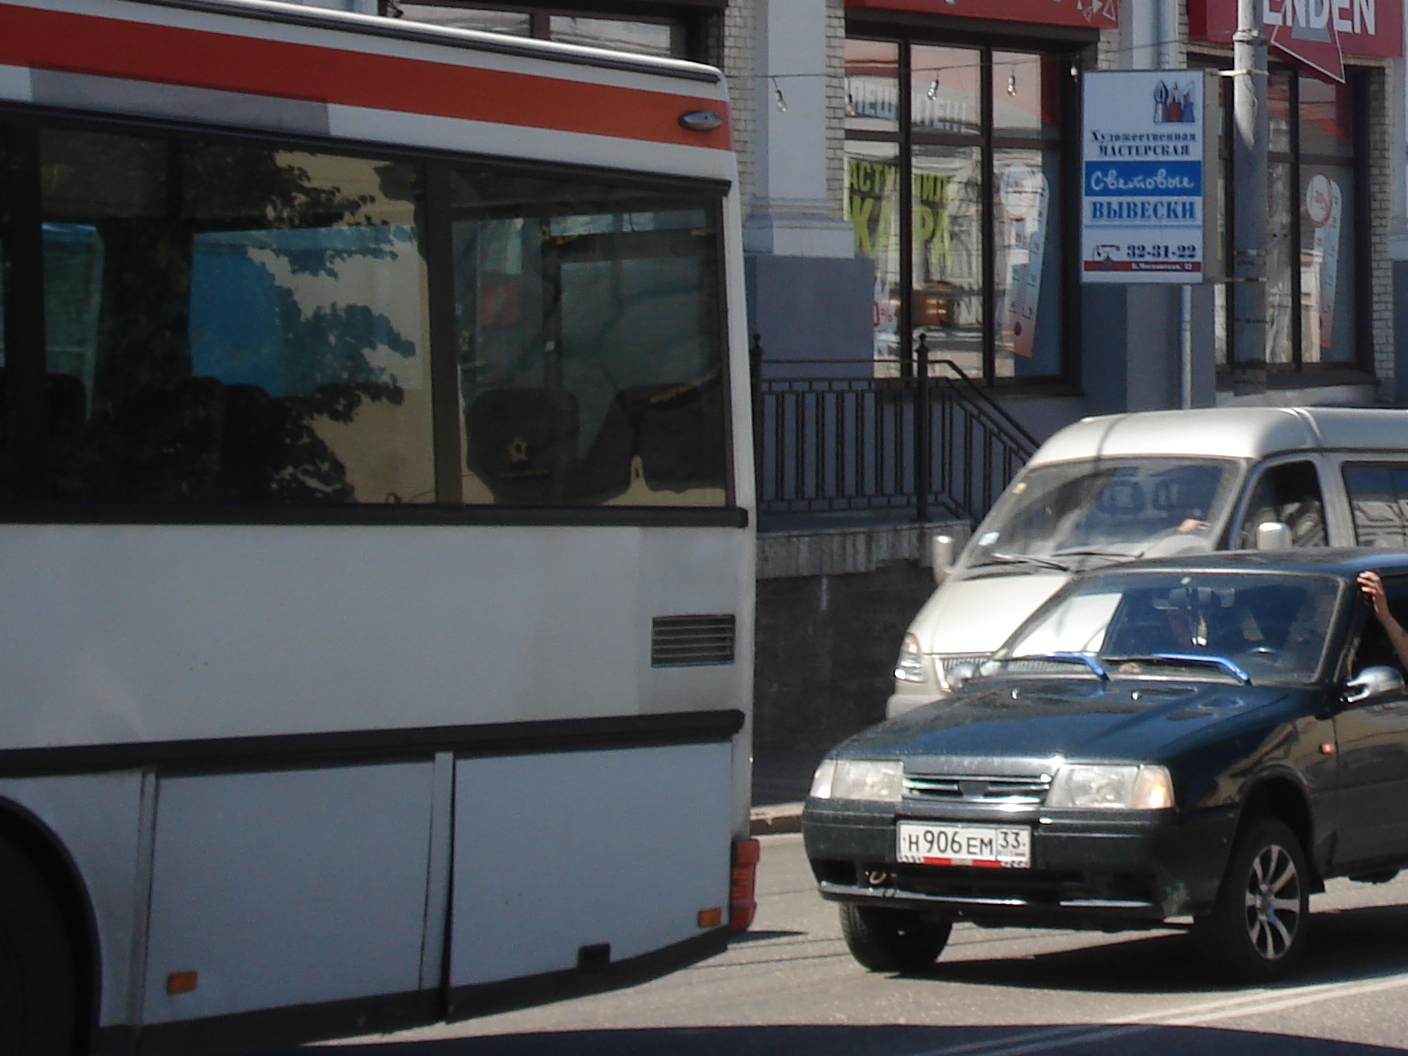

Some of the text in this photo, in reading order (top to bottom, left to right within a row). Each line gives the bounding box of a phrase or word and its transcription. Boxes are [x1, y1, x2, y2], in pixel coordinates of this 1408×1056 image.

[1090, 130, 1196, 144] Художественная
[1098, 144, 1190, 157] МАСТЕРСКАЯ
[1090, 167, 1196, 191] Световые
[1091, 200, 1195, 220] ВЫВЕСКИ
[1126, 244, 1197, 259] 32-31-22
[999, 831, 1021, 849] 33
